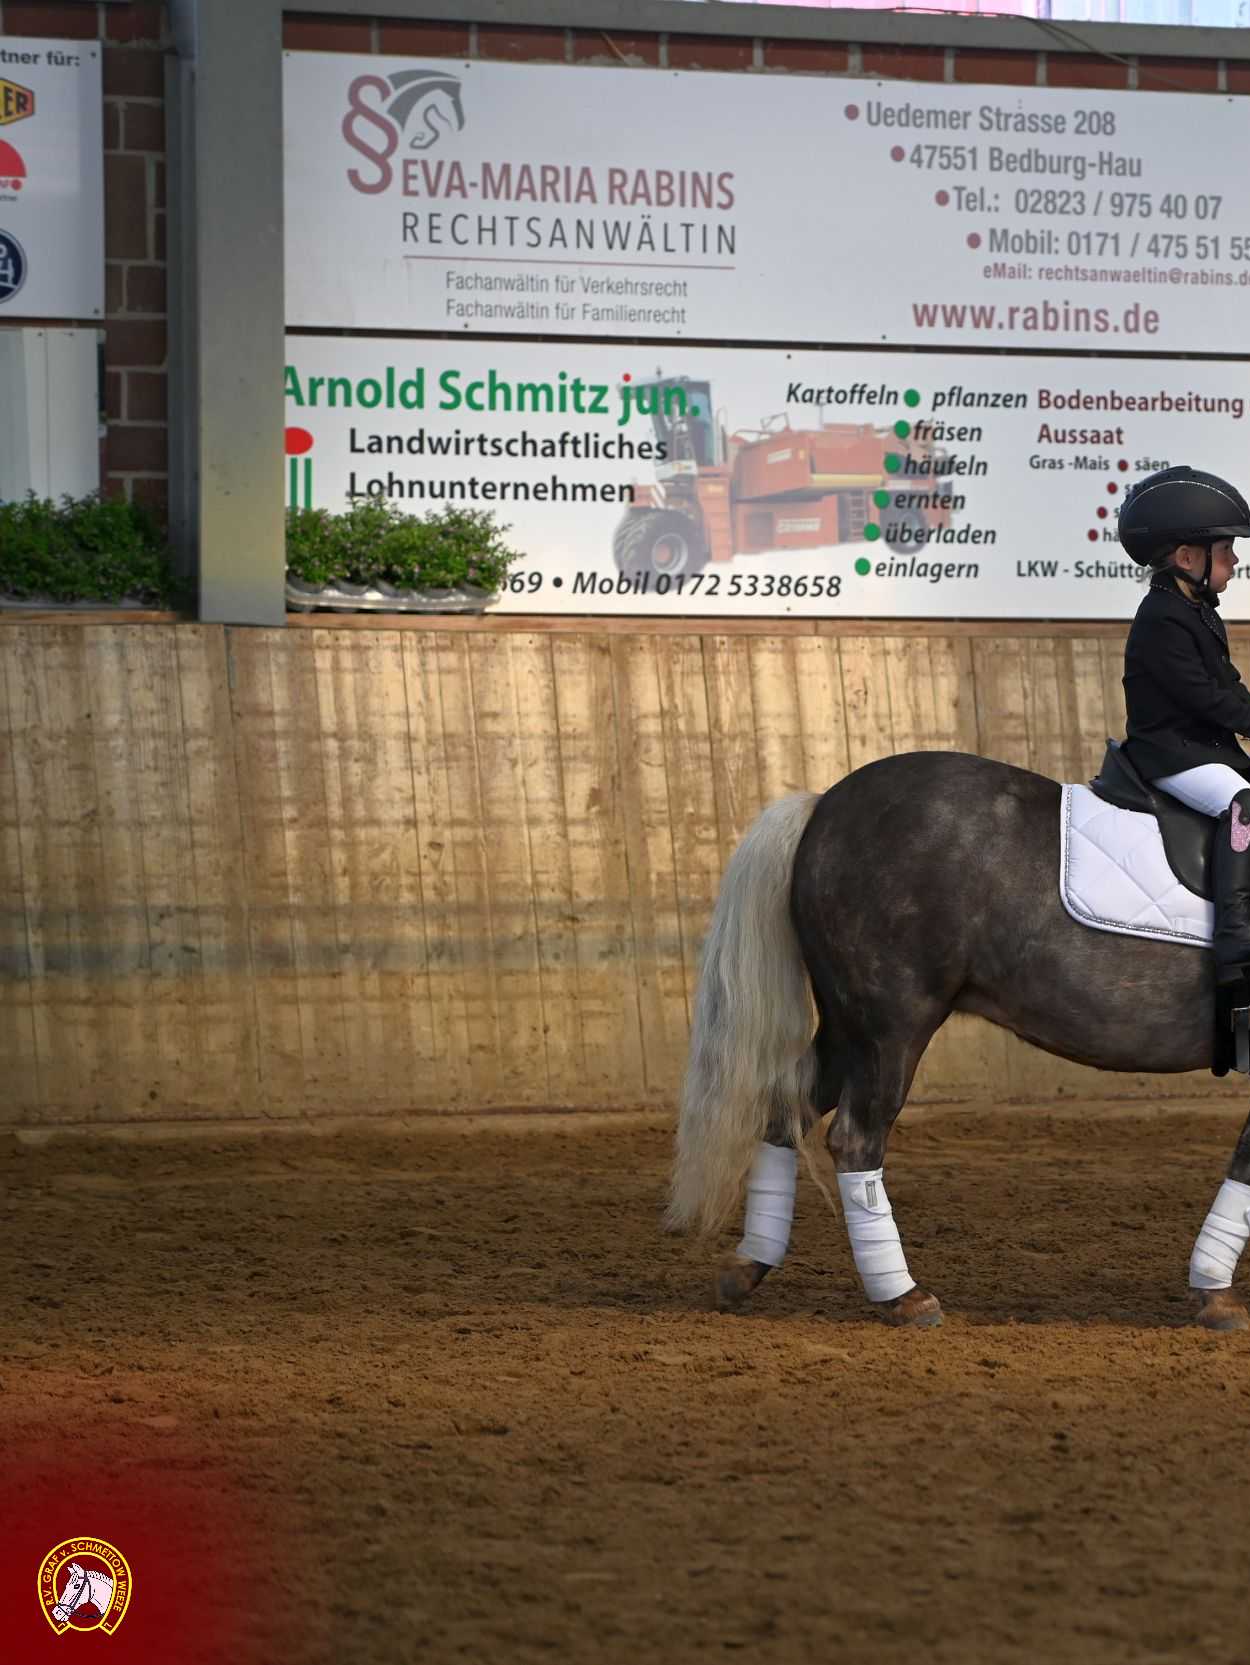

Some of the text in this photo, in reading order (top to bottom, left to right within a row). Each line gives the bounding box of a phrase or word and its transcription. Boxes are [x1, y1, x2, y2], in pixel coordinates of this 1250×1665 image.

[46, 51, 80, 67] für:
[866, 101, 971, 131] Uedemer
[1073, 109, 1117, 136] 208
[909, 145, 1142, 180] 47551 Bedburg-Hau
[401, 159, 736, 211] EVA-MARIA RABINS
[952, 186, 1222, 220] Tel.: 02823 / 975 40 07
[402, 211, 737, 255] RECHTSANWÄLTIN
[988, 227, 1061, 256] Mobil:
[1067, 231, 1121, 257] 0171
[1130, 232, 1141, 257] /
[1146, 233, 1188, 259] 475
[1195, 235, 1221, 260] 51
[446, 271, 688, 298] Fachanwältin für Verkehrsrecht
[983, 263, 1033, 280] eMail:
[446, 299, 686, 325] Fachanwältin für Familienrecht
[912, 300, 1160, 335] www.rabins.de
[285, 366, 700, 427] Arnold Schmitz jun.
[786, 382, 1028, 412] Kartoffeln pflanzen
[1038, 389, 1244, 419] Bodenbearbeitung
[349, 428, 668, 461] Landwirtschaftliches
[912, 419, 983, 444] fräsen
[1037, 423, 1124, 445] Aussaat
[904, 454, 988, 478] häufeln
[1029, 454, 1065, 472] Gras
[1135, 457, 1170, 471] säen
[349, 472, 636, 503] Lohnunternehmen
[894, 492, 966, 511] ernten
[884, 524, 997, 546] überladen
[572, 569, 649, 595] Mobil
[656, 573, 722, 597] 0172
[726, 574, 842, 599] 5338658
[874, 558, 979, 584] einlagern
[1016, 560, 1057, 578] LKW
[1074, 560, 1148, 583] Schüttg
